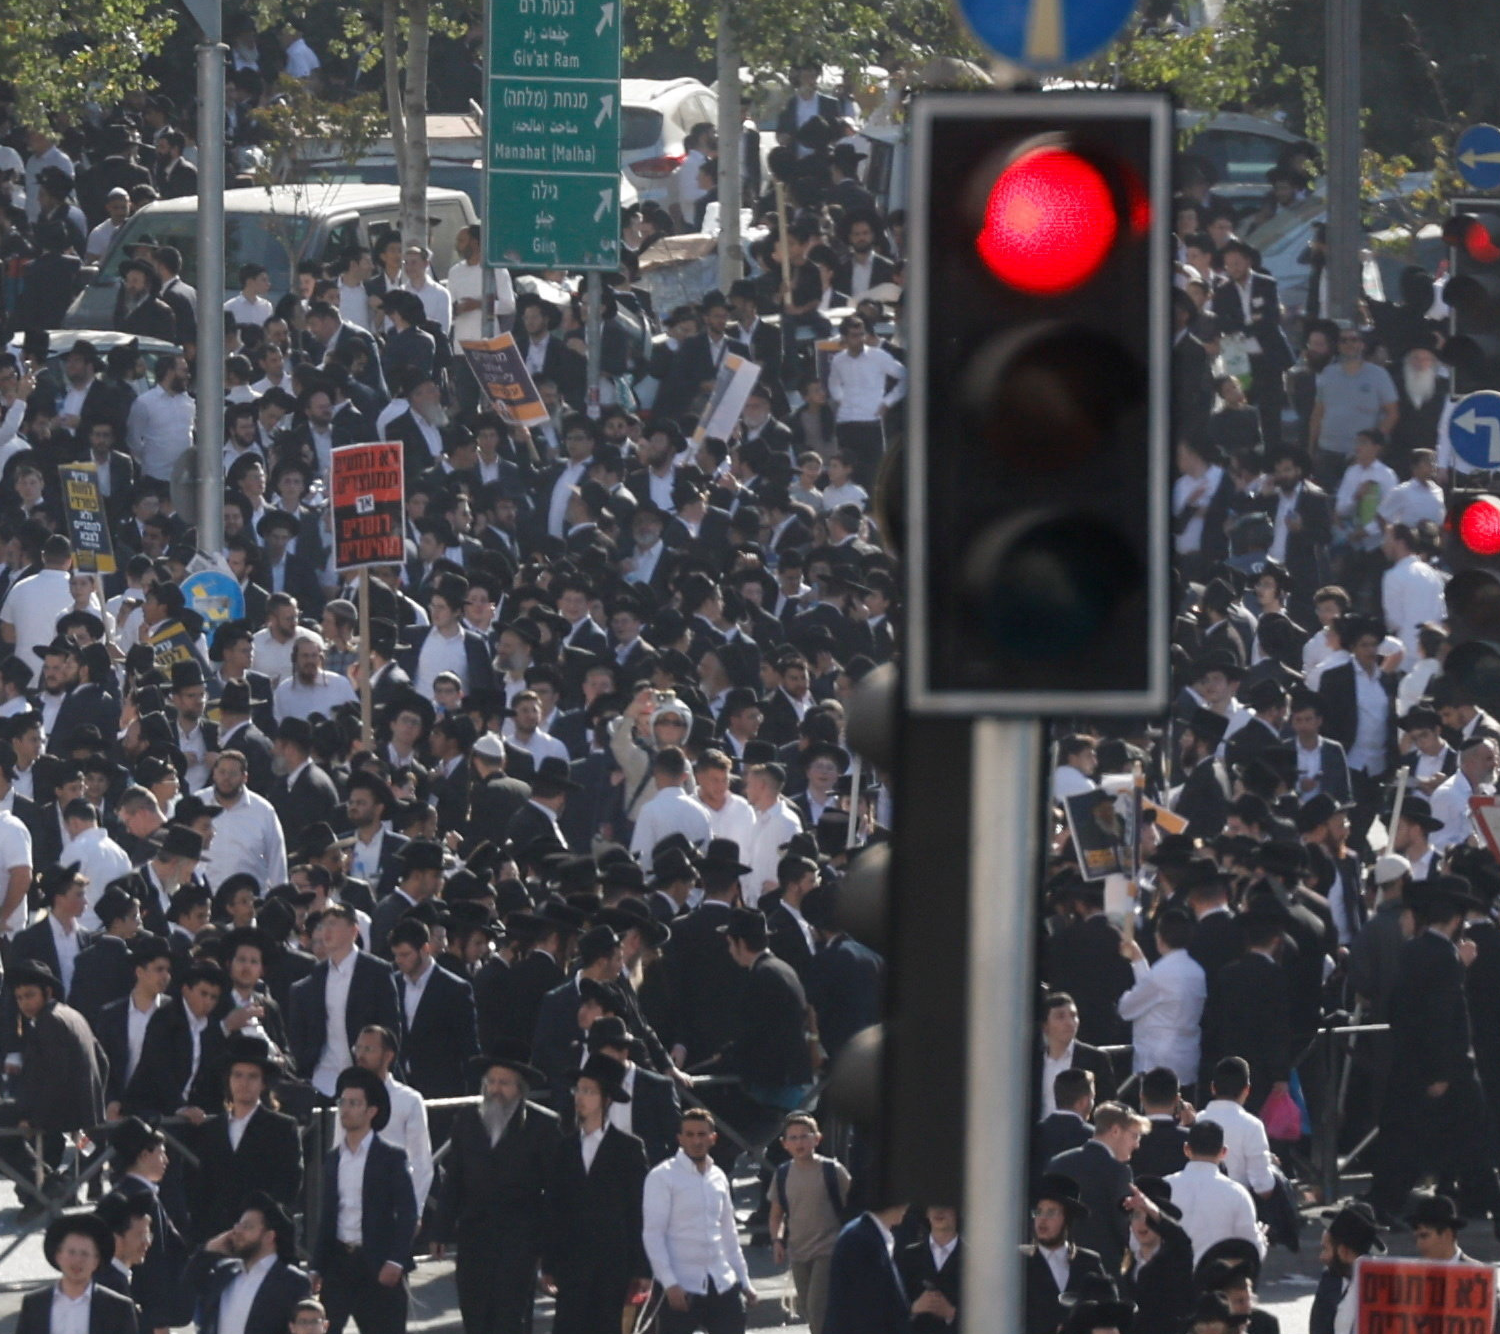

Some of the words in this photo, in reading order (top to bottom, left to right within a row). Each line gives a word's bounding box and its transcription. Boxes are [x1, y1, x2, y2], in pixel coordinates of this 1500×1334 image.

[542, 0, 575, 15] גבעת
[514, 49, 549, 67] Giv'at
[554, 52, 580, 68] Ram
[504, 87, 547, 109] (מלחה)
[553, 91, 588, 109] מנחת
[495, 143, 545, 160] Manahat
[552, 145, 596, 164] (Malha)
[532, 180, 558, 200] גילה
